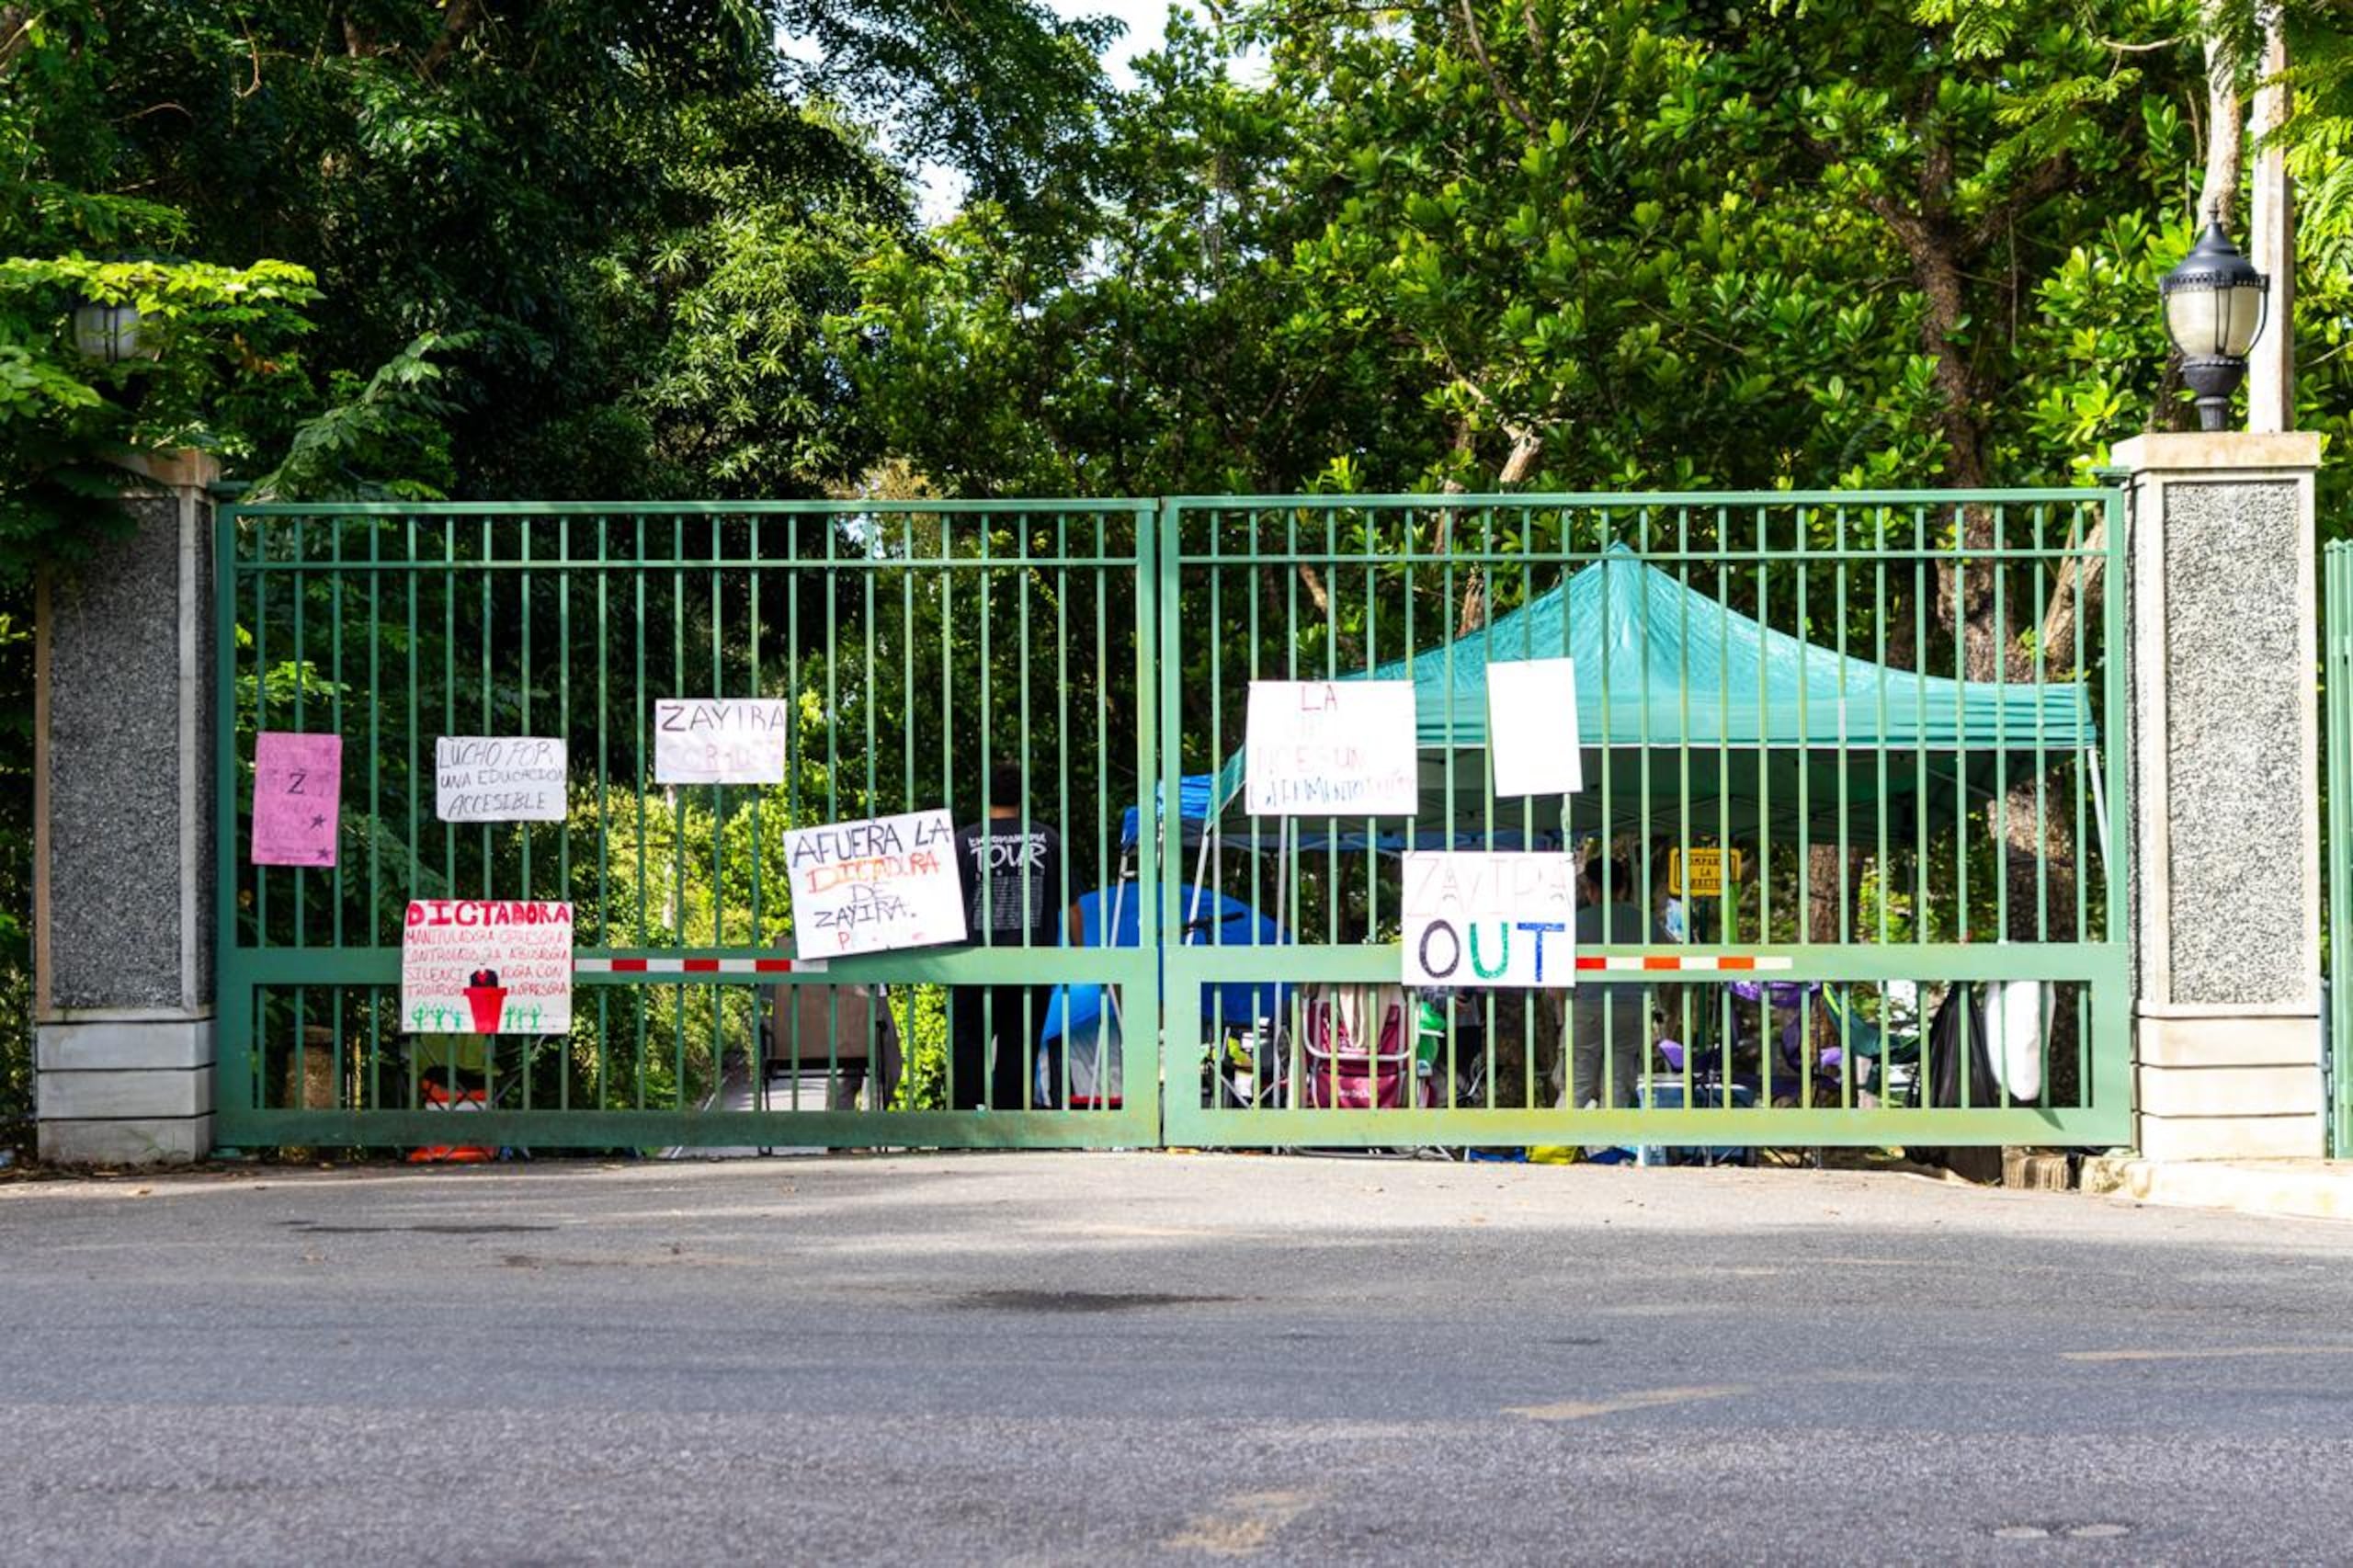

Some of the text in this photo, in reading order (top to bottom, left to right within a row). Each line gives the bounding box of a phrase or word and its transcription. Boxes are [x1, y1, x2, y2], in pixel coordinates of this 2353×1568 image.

[1301, 683, 1339, 713] LA
[660, 705, 784, 732] ZAYIRA
[438, 740, 554, 769] LUCHO POR
[439, 771, 472, 790] UNA
[447, 790, 546, 819] ACCESIBLE
[791, 823, 904, 869] AFUERA
[914, 816, 950, 847] LA
[971, 842, 1048, 873] TOUR
[848, 881, 895, 903] DE
[405, 900, 571, 928] DICTADORA
[1418, 918, 1566, 983] OUT
[536, 965, 563, 981] CON
